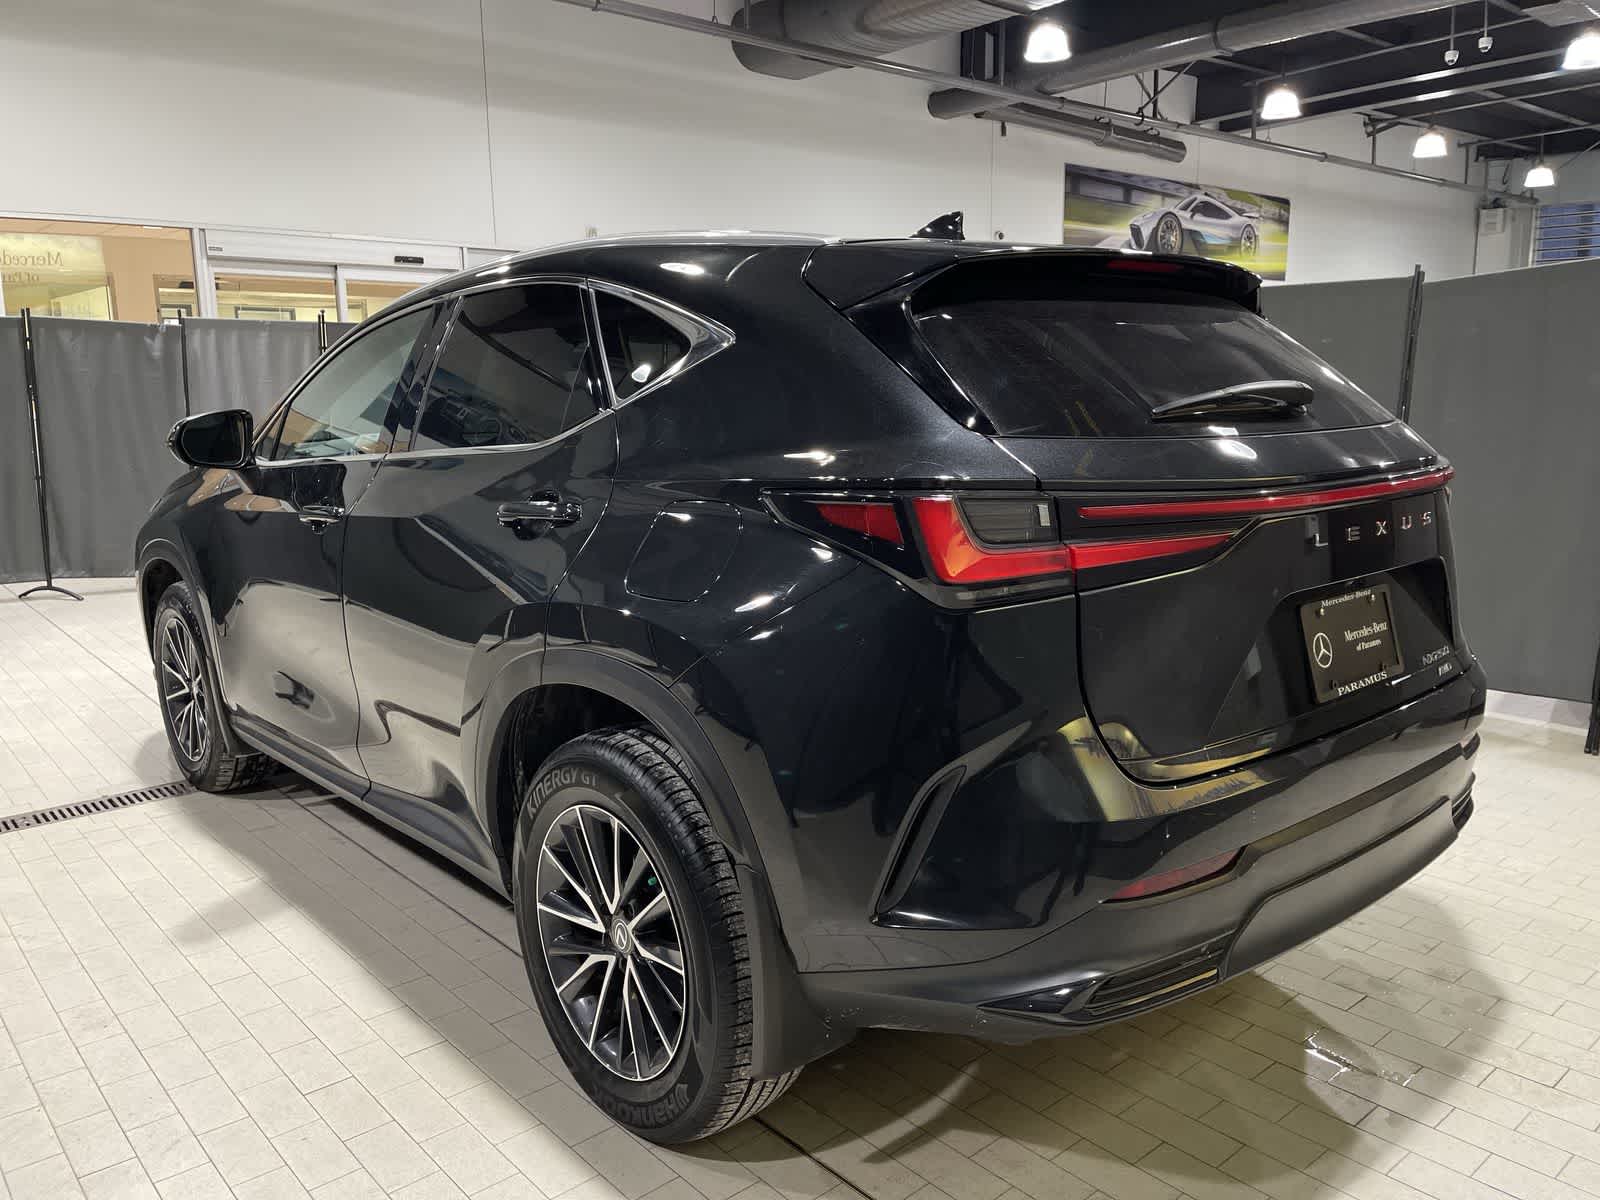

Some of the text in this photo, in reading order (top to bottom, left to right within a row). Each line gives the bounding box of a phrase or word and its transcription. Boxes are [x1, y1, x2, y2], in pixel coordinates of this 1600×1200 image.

[1314, 511, 1432, 547] LEXUS
[1321, 588, 1372, 608] Mercedes-Benz
[1344, 621, 1388, 642] Mercedes-Benz
[1337, 671, 1388, 696] PARAMUS
[527, 767, 579, 819] KINERGY
